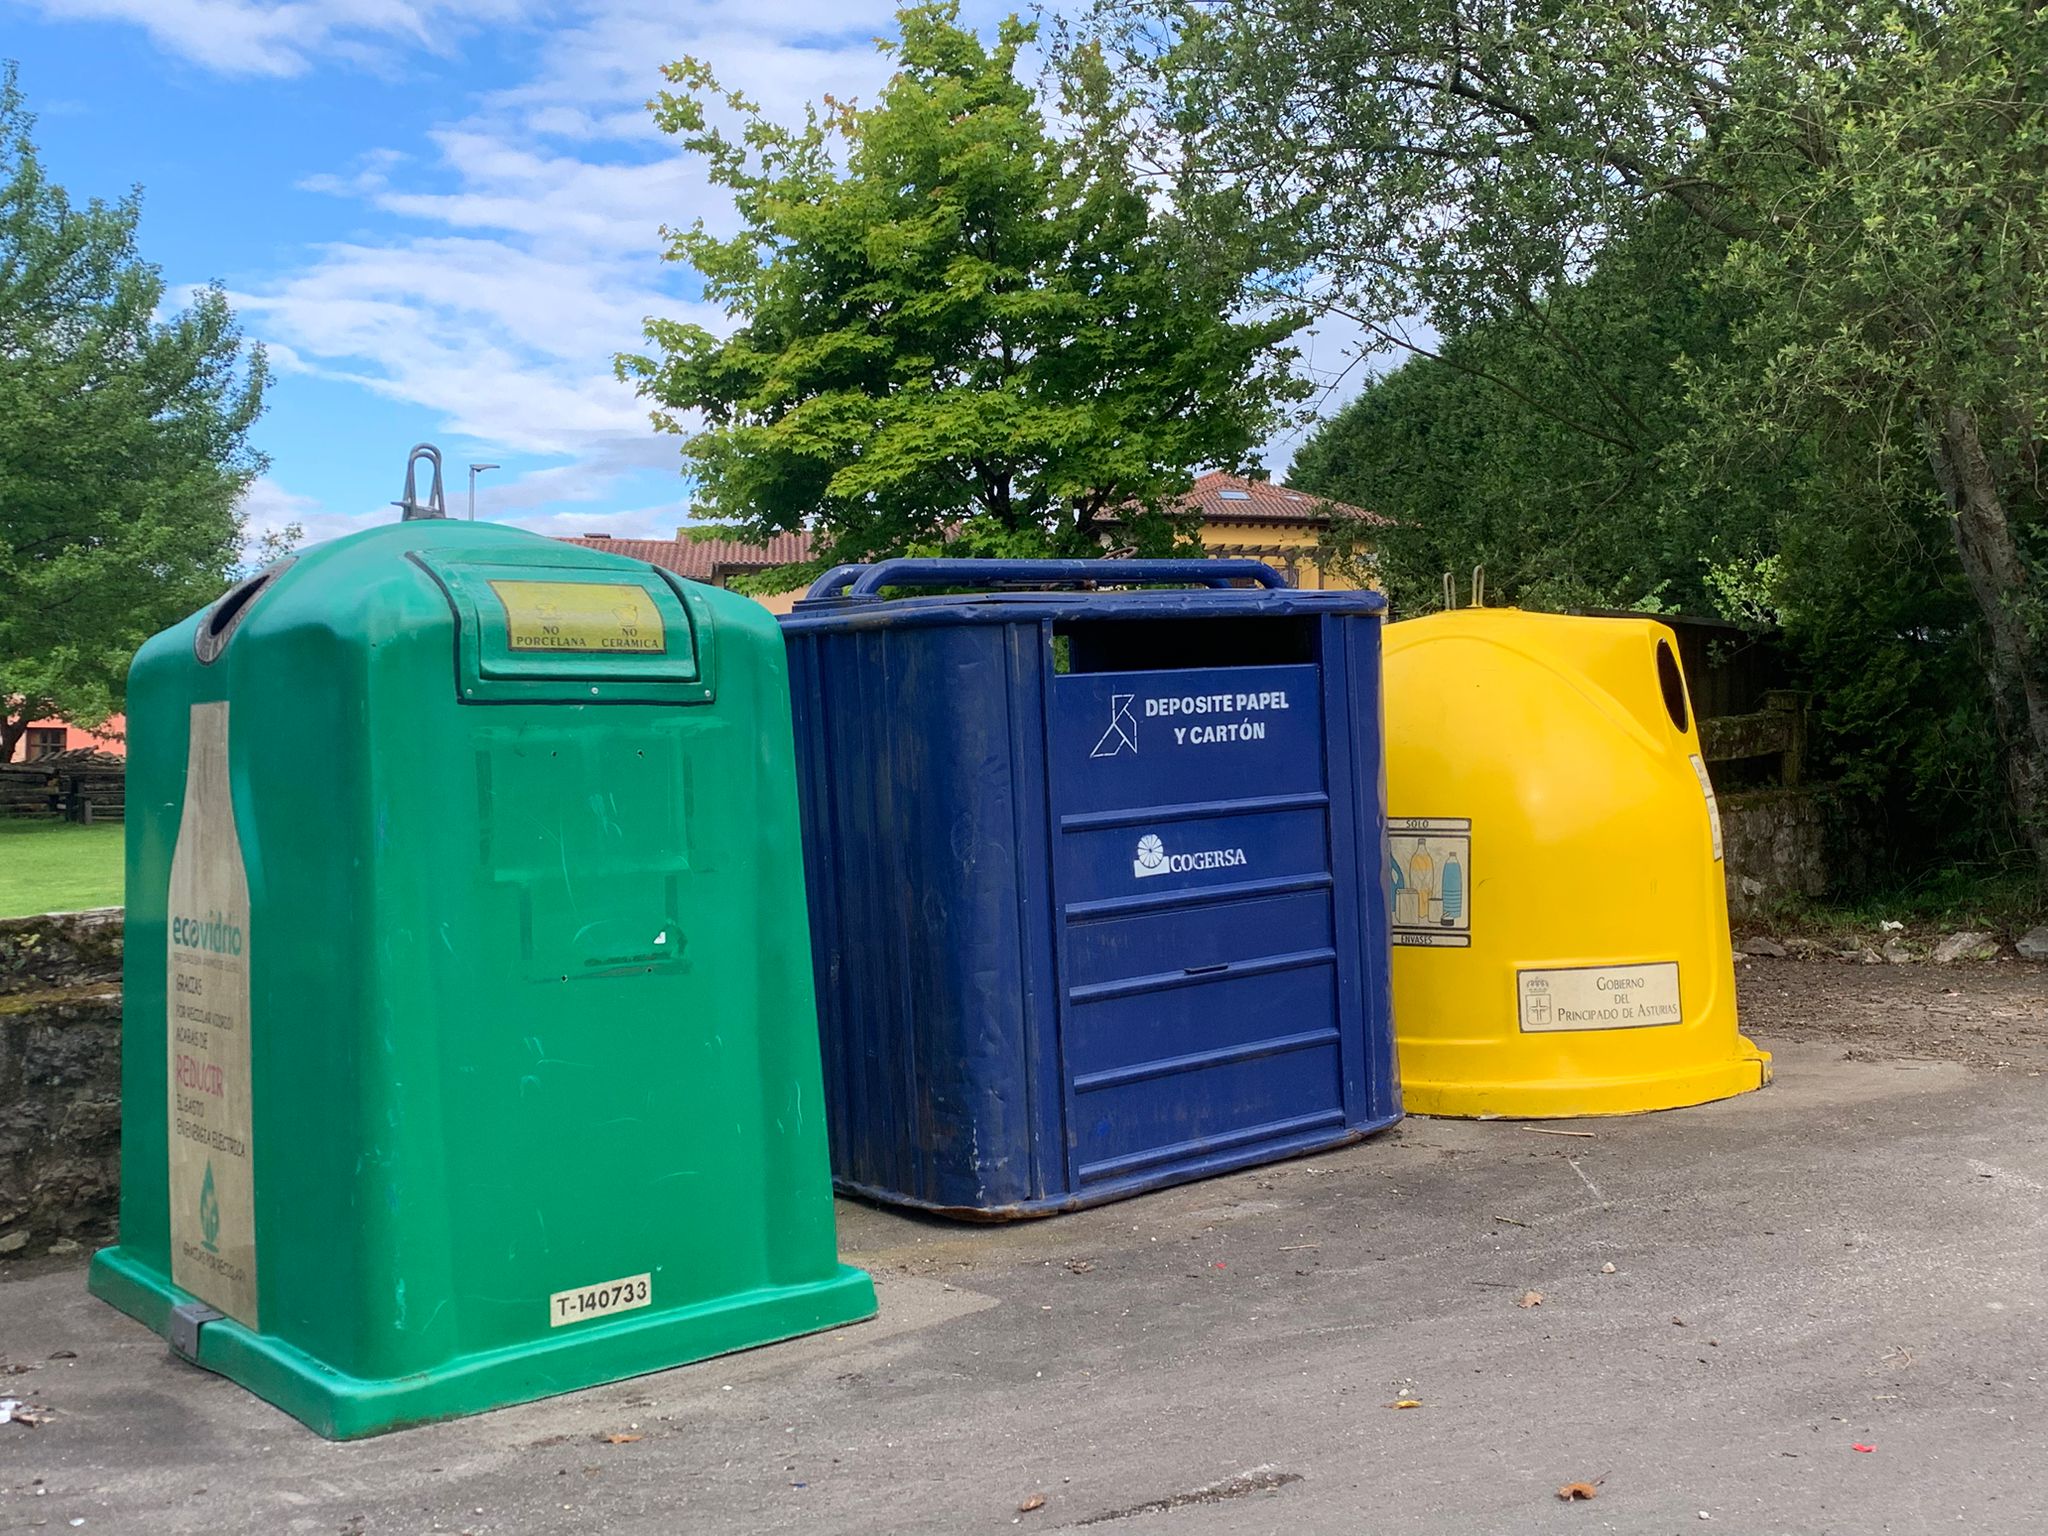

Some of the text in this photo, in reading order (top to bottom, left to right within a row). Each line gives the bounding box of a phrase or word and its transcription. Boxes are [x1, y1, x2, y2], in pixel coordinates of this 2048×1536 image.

[542, 625, 560, 635] NO
[621, 627, 638, 638] NO
[516, 636, 587, 647] PORCELANA
[601, 637, 659, 649] CERAMICA
[1145, 691, 1290, 717] DEPOSITE PAPEL
[1174, 718, 1265, 745] Y CARTÓN
[1406, 819, 1429, 829] SOLO
[1170, 848, 1247, 873] COGERSA
[173, 910, 242, 956] ecovidrio
[1400, 935, 1433, 945] ENVASES
[1596, 976, 1645, 991] GOBIERNO
[1614, 993, 1630, 1005] DEL
[1557, 1003, 1678, 1022] PRINCIPADO DE ASTURIAS
[176, 1054, 224, 1099] REDUCIR
[556, 1281, 647, 1316] T-140733
